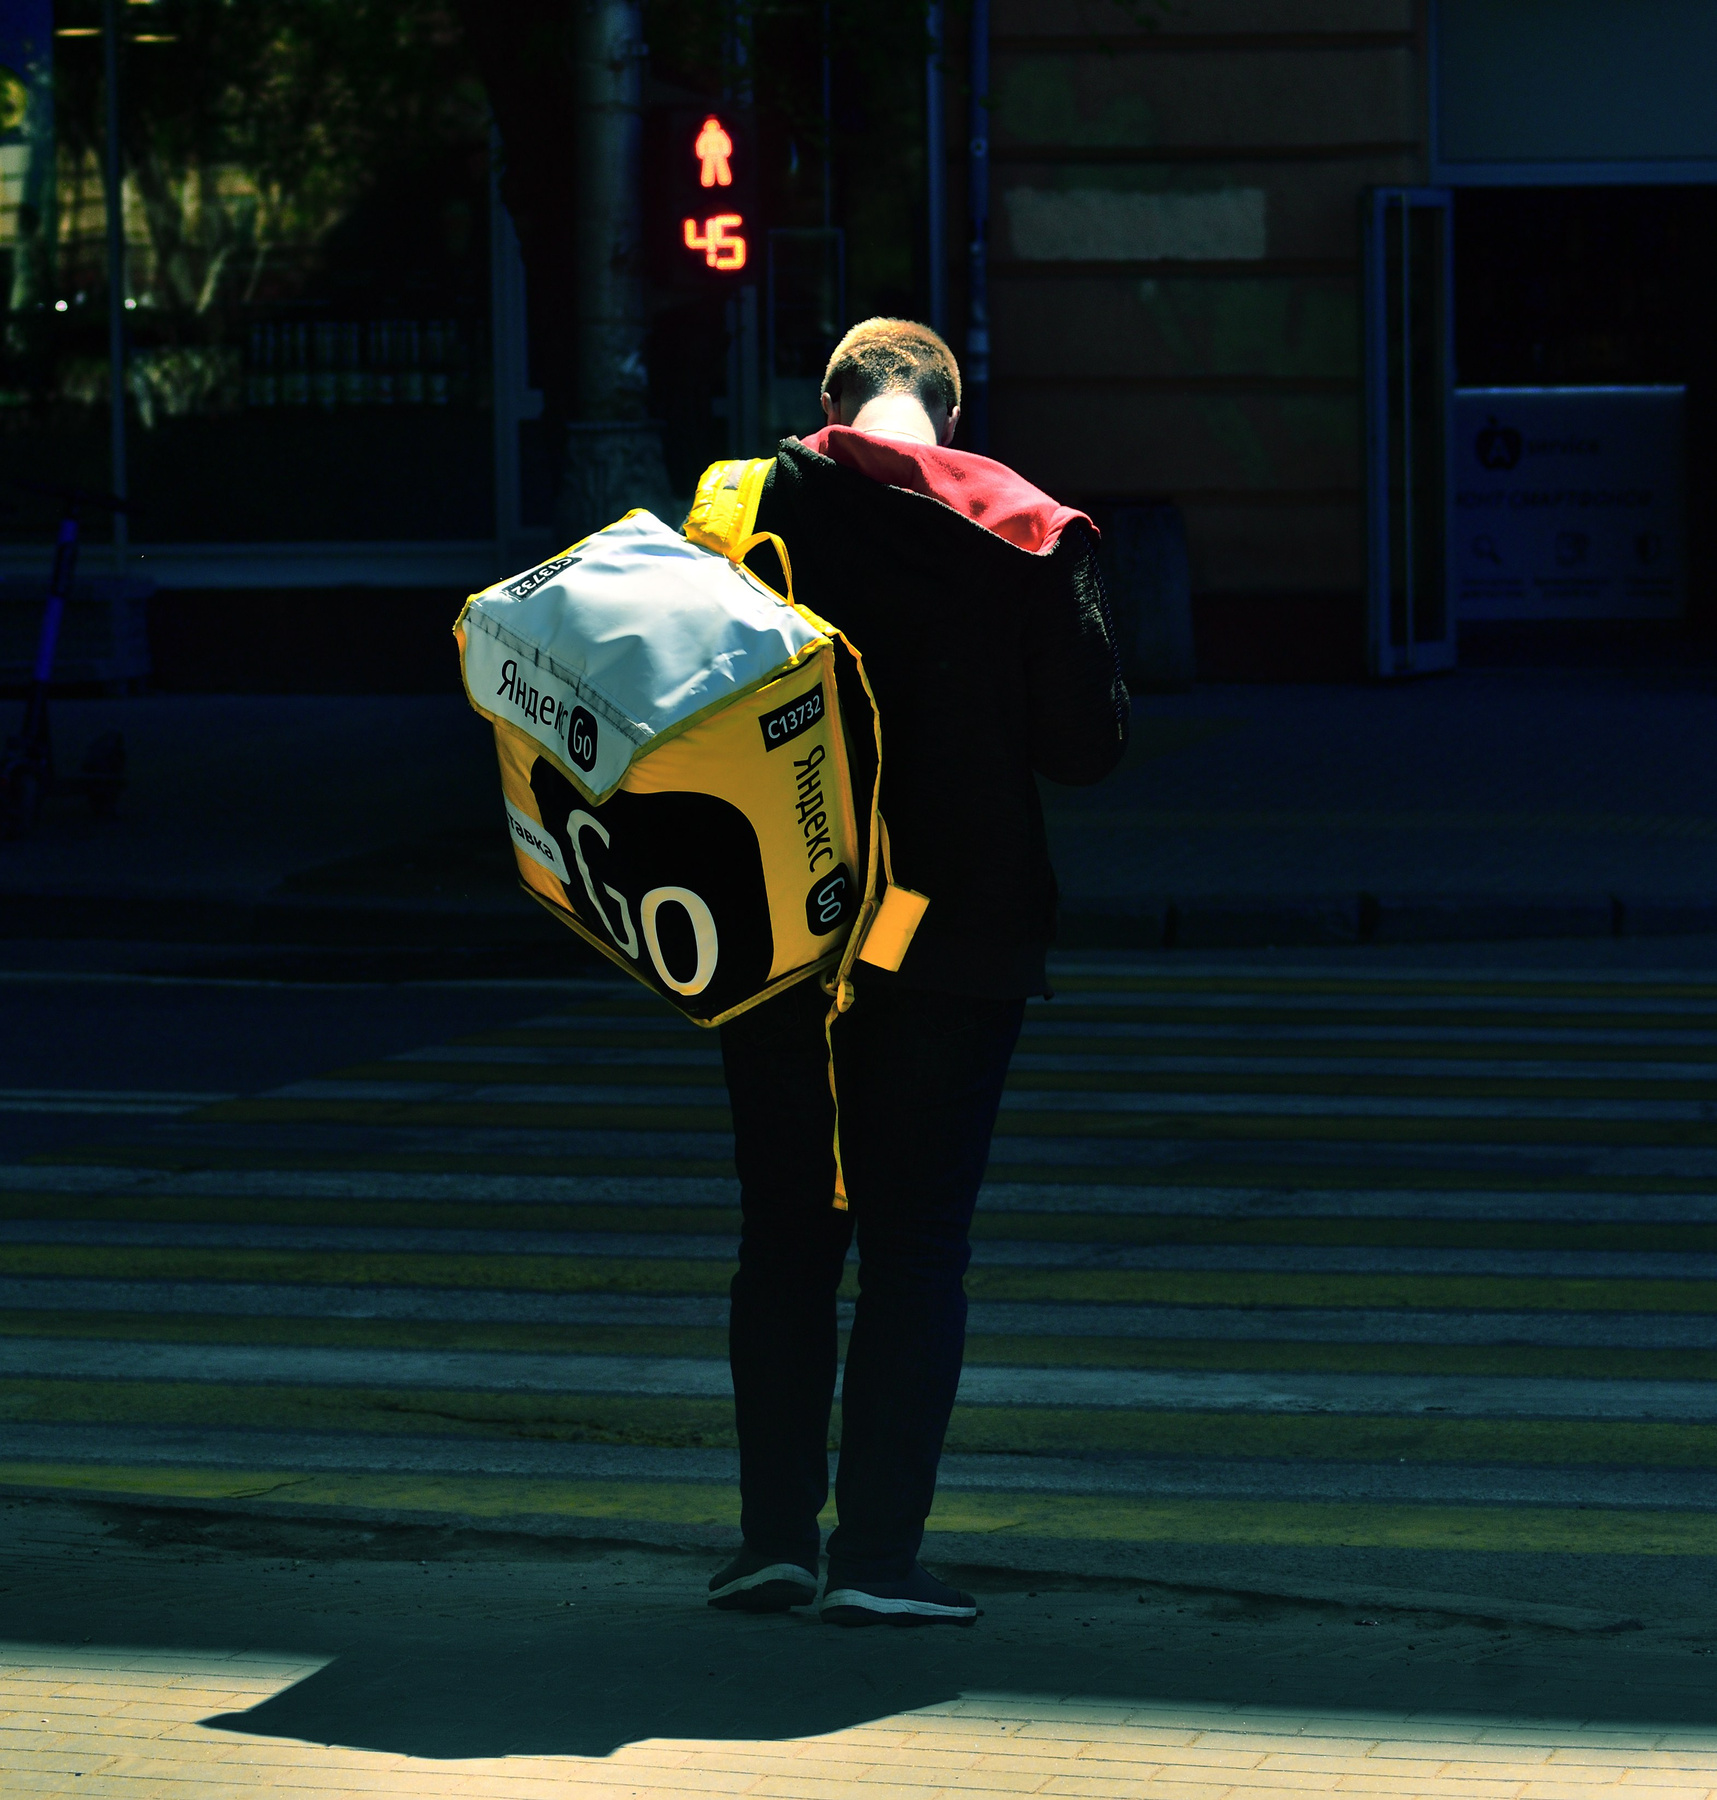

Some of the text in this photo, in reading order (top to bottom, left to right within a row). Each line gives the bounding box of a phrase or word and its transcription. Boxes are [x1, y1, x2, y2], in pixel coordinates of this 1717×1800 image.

[683, 213, 747, 271] 45
[573, 718, 593, 761] Go
[767, 694, 822, 739] C13732
[793, 744, 846, 923] Яндекс Go
[566, 808, 719, 997] Go
